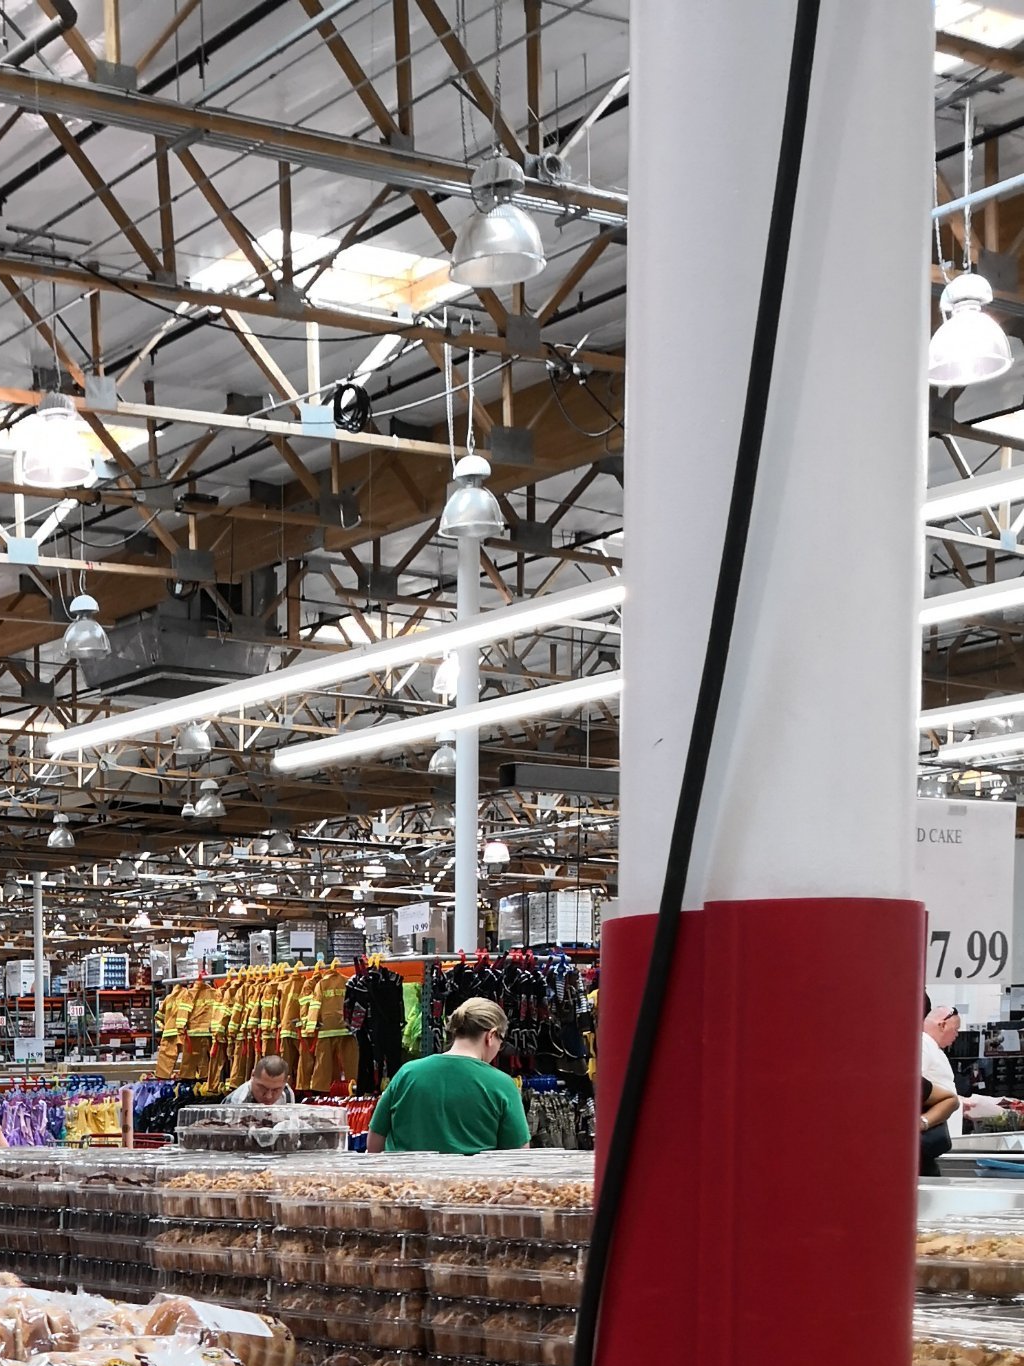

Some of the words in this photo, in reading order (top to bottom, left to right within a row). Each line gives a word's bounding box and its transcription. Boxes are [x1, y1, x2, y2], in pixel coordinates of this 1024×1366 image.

[929, 829, 963, 844] CAKE
[929, 930, 1009, 979] 7.99
[71, 1006, 83, 1016] 310
